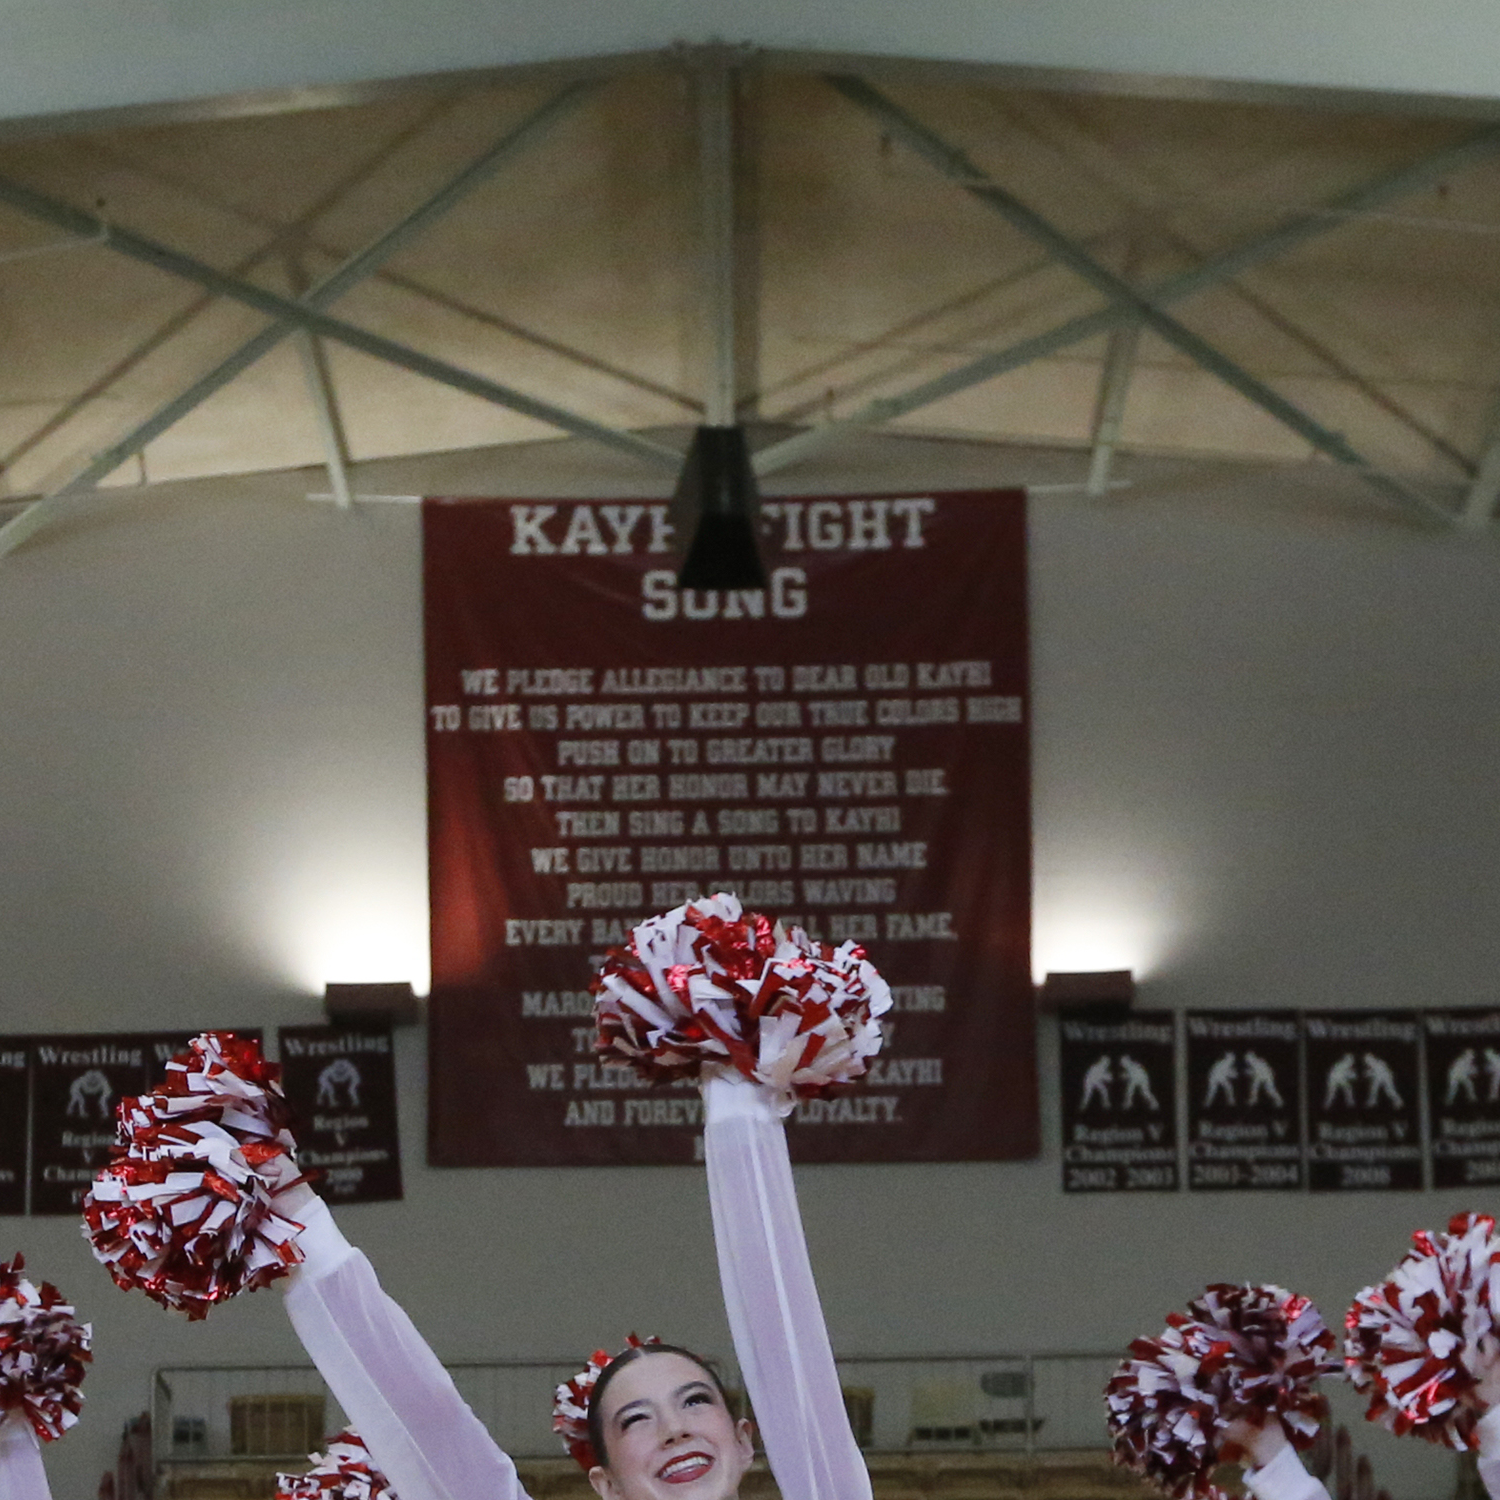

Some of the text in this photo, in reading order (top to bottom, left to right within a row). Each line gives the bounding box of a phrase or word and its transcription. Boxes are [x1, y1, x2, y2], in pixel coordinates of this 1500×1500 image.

[510, 505, 675, 555] KAY
[642, 567, 807, 621] SONG
[461, 660, 992, 694] WE PLEDGE ALLEGIANCE TO DEAR OLD KAYHI
[431, 704, 460, 731] TO
[468, 704, 521, 731] GIVE
[529, 704, 558, 731] US
[566, 703, 644, 730] POWER
[651, 703, 681, 729] TO
[689, 702, 750, 730] KEEP
[558, 735, 896, 766] PUSH ON TO GREATER GLORY
[503, 775, 534, 802] SO
[540, 775, 605, 801] THAT
[612, 774, 660, 801] HER
[669, 773, 748, 799] HONOR
[757, 772, 809, 798] MAY
[817, 771, 898, 797] NEVER
[555, 806, 900, 837] THEN SING A SONG TO KAYHI
[531, 842, 927, 873] WE GIVE HONOR UNTO HER NAME
[567, 882, 643, 909] PROUD
[652, 881, 698, 907] HER
[803, 878, 896, 904] WAVING
[505, 918, 584, 945] EVERY
[831, 914, 877, 940] HER
[1064, 1022, 1172, 1044] Wrestling
[1189, 1018, 1298, 1041] Wrestling
[1307, 1018, 1417, 1042] Wrestling
[39, 1045, 142, 1068] Wrestling
[284, 1034, 389, 1056] Wrestling
[527, 1063, 565, 1090] WE
[313, 1114, 369, 1132] Region
[564, 1100, 615, 1126] AND
